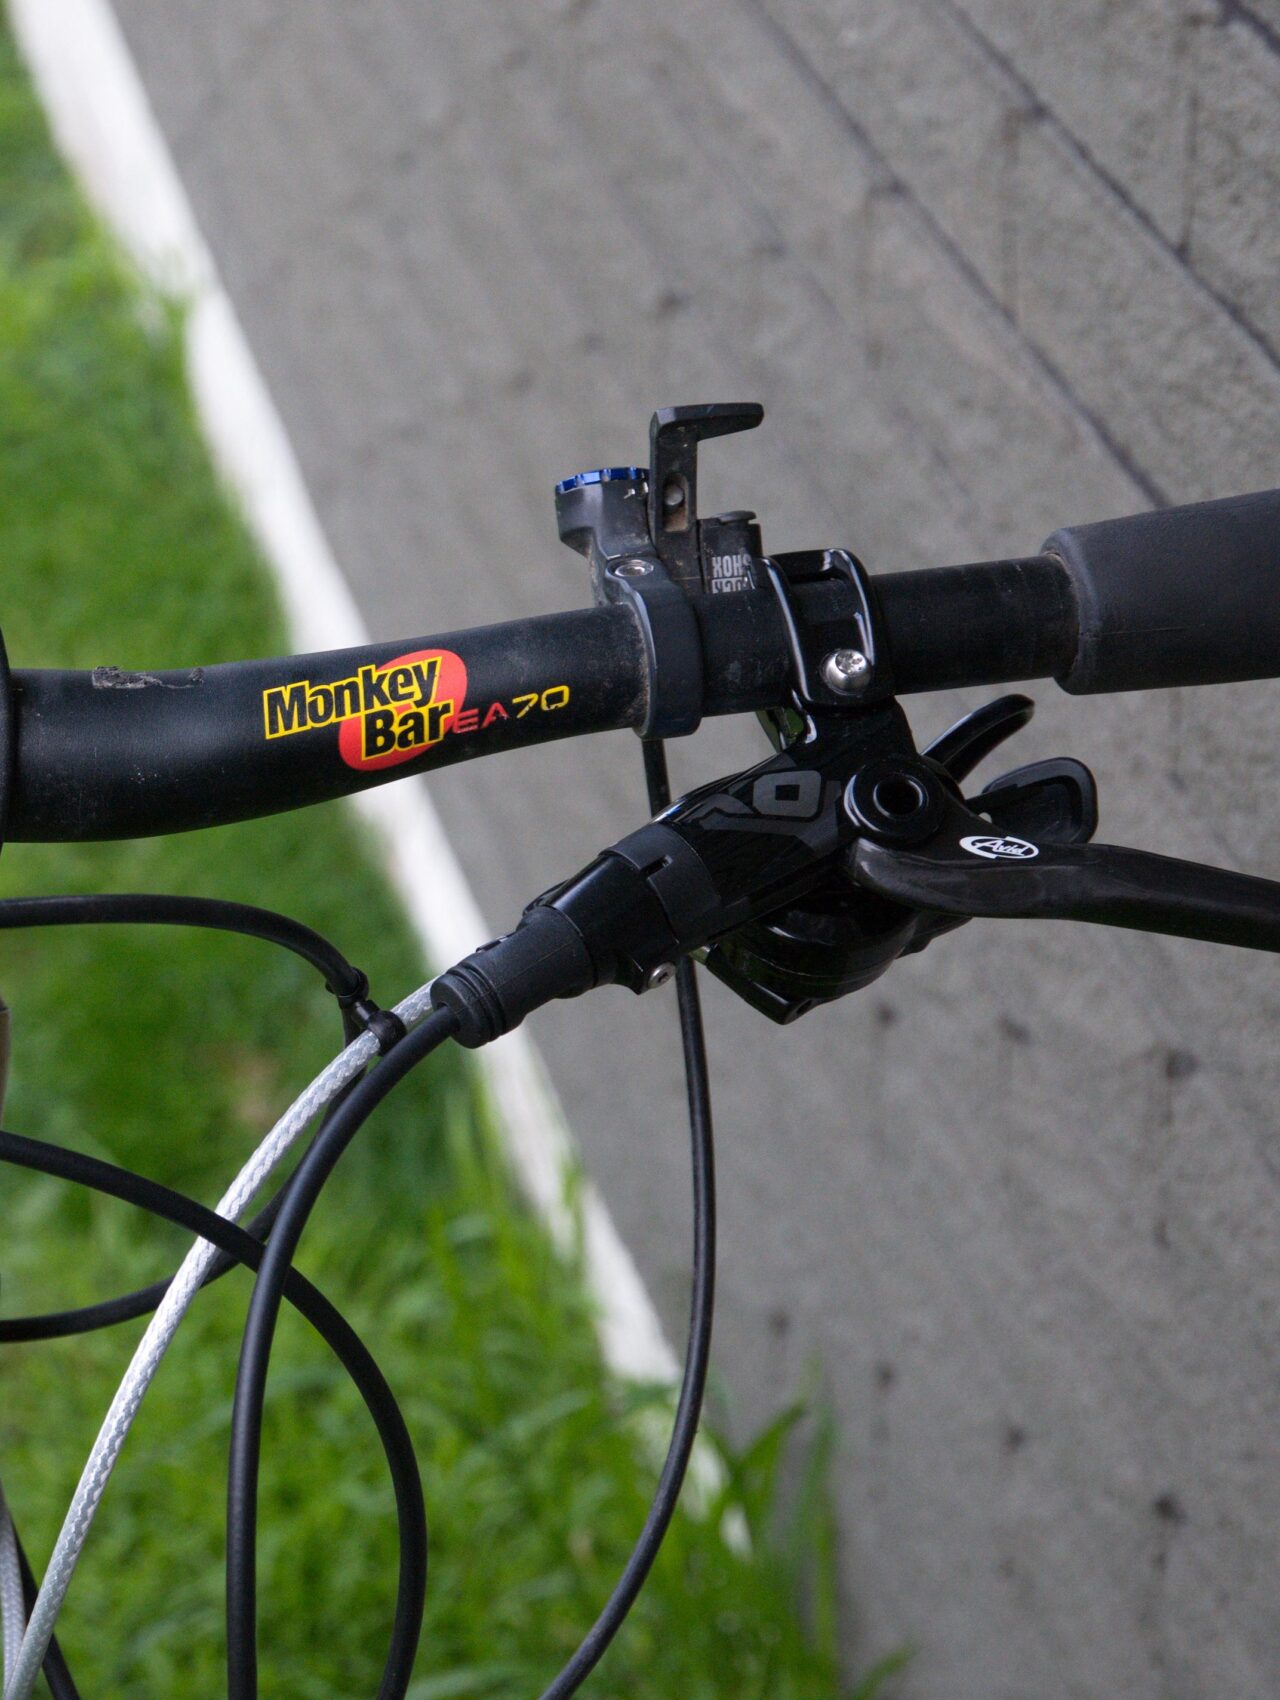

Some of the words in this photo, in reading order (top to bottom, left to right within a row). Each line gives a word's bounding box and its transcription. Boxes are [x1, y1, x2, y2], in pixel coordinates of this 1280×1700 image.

[262, 656, 442, 740] Monkey
[452, 685, 570, 735] EA70
[361, 699, 455, 761] Bar
